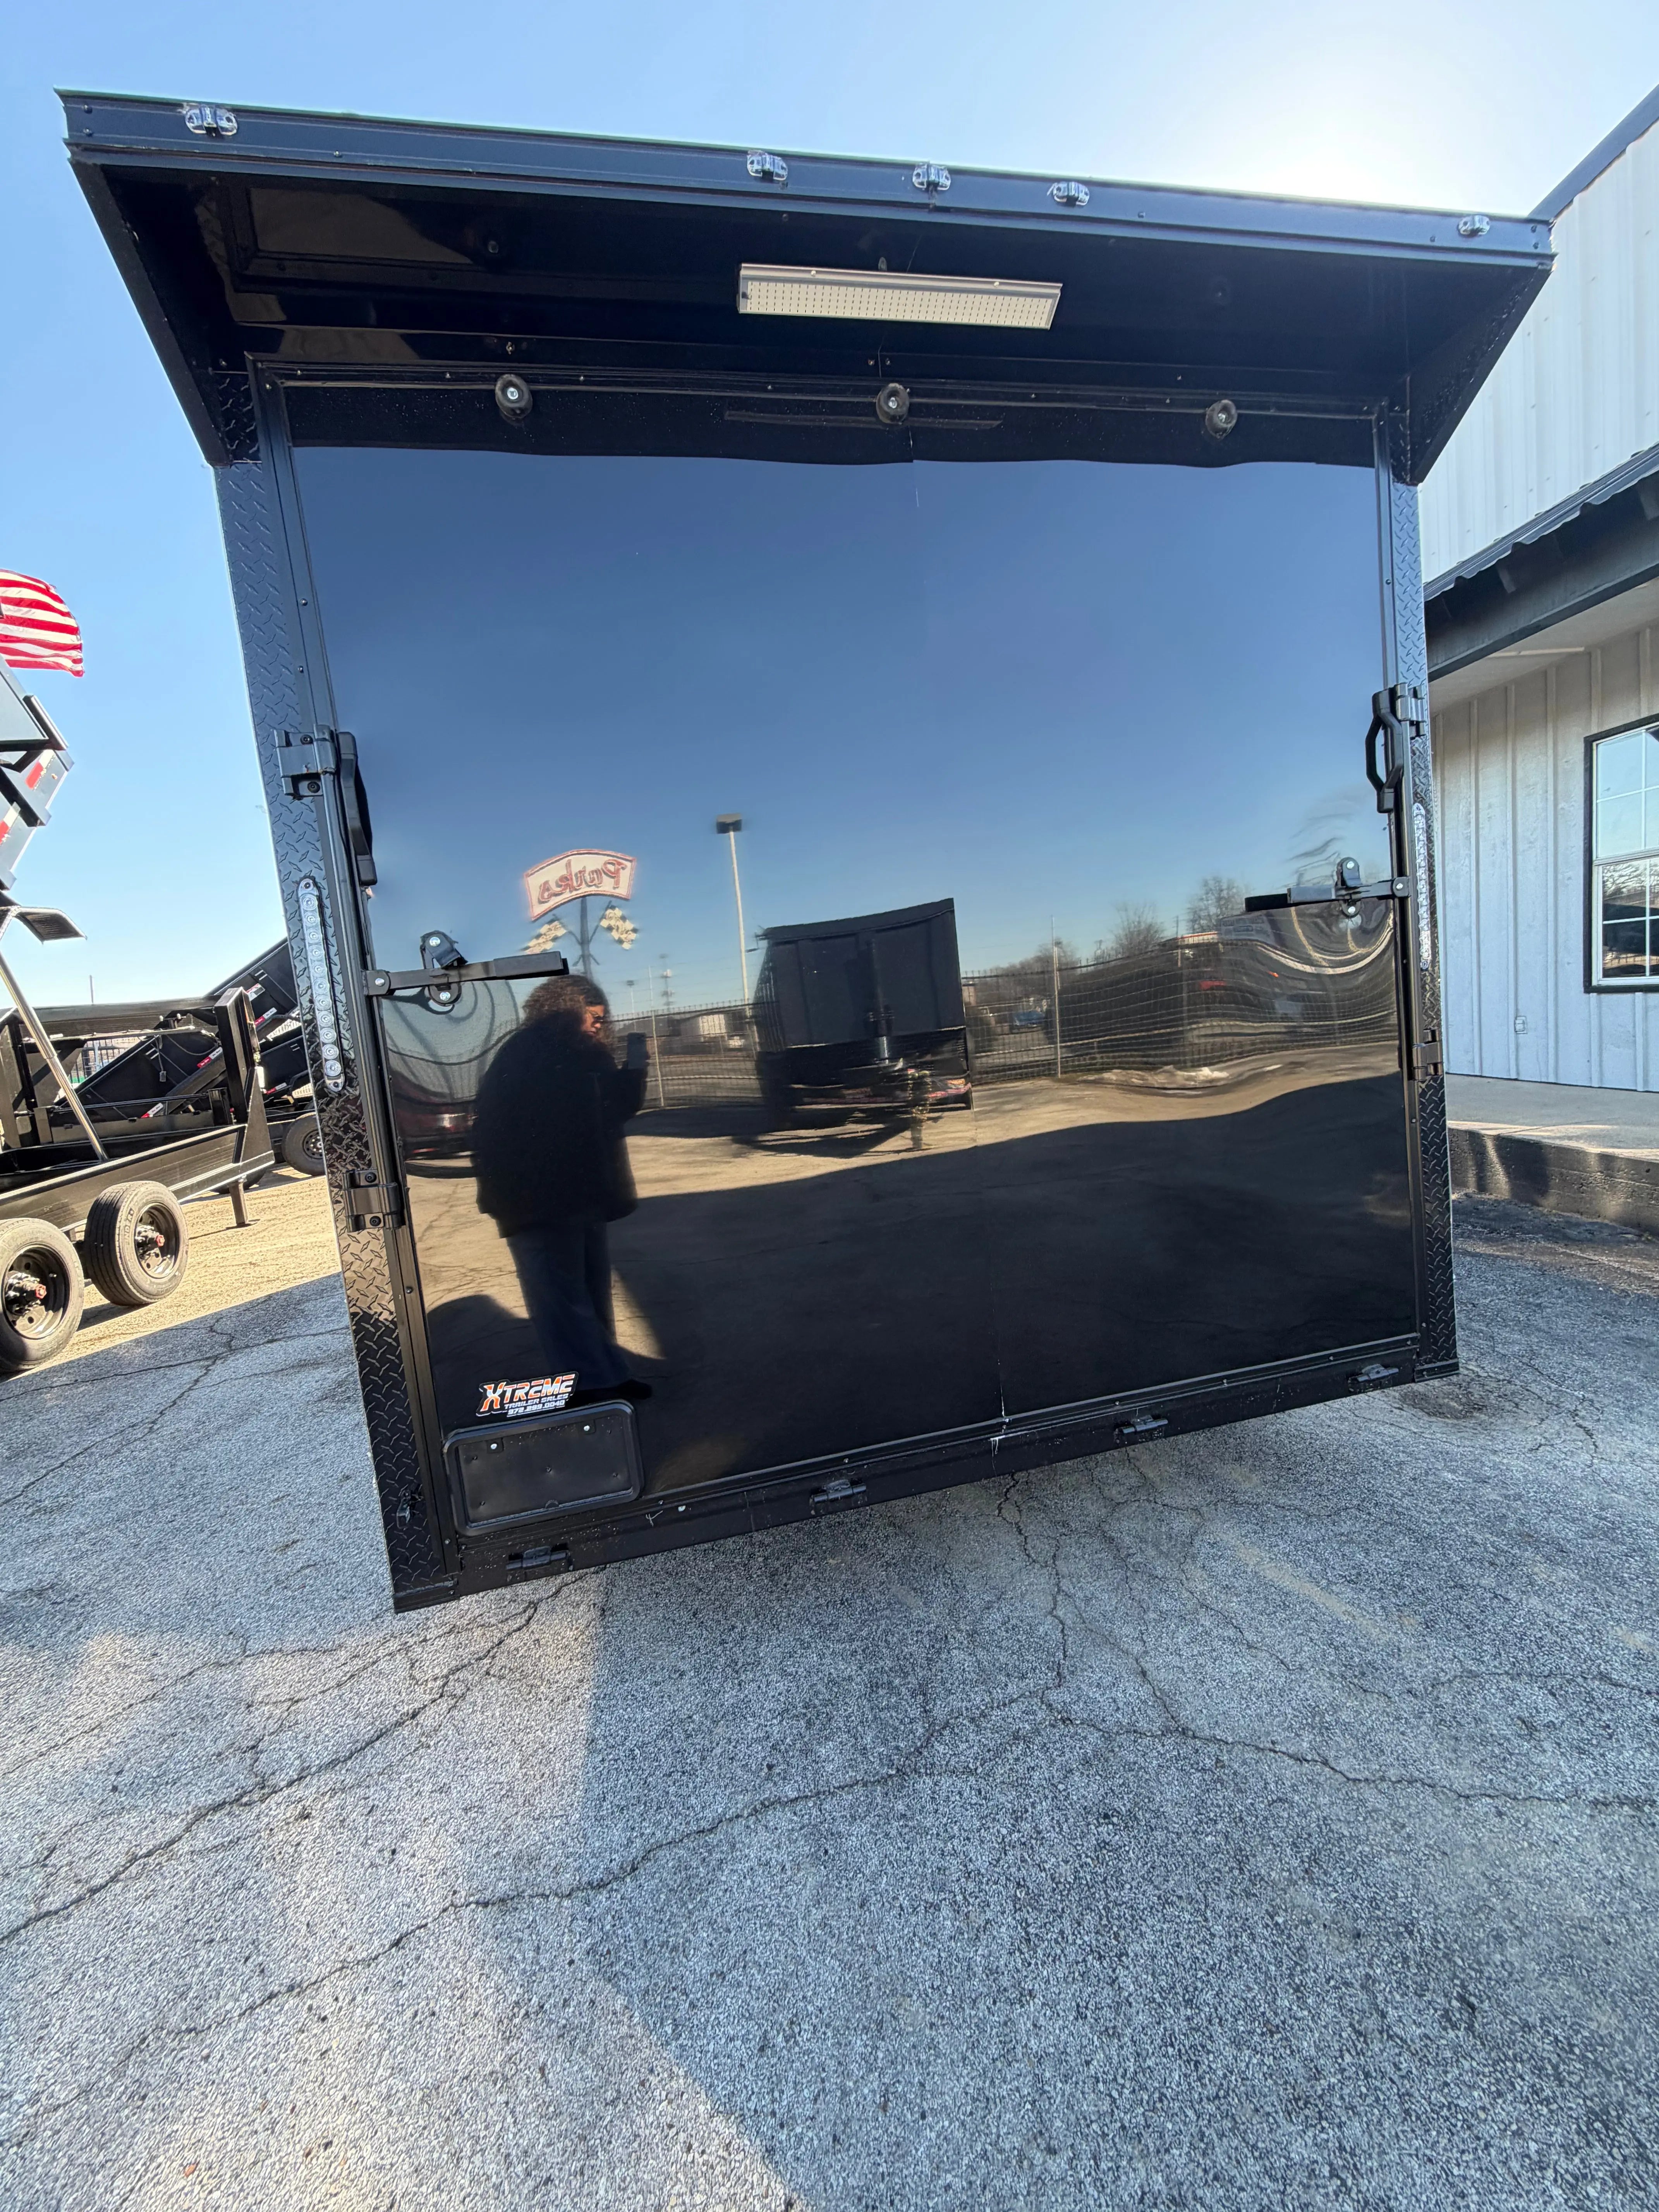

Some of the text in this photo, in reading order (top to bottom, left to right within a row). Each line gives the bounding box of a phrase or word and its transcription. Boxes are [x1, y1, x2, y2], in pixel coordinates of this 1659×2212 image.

[480, 1374, 575, 1412] XTREME
[504, 1393, 569, 1409] TRAILER SALES
[508, 1400, 565, 1415] 972.299.0040
